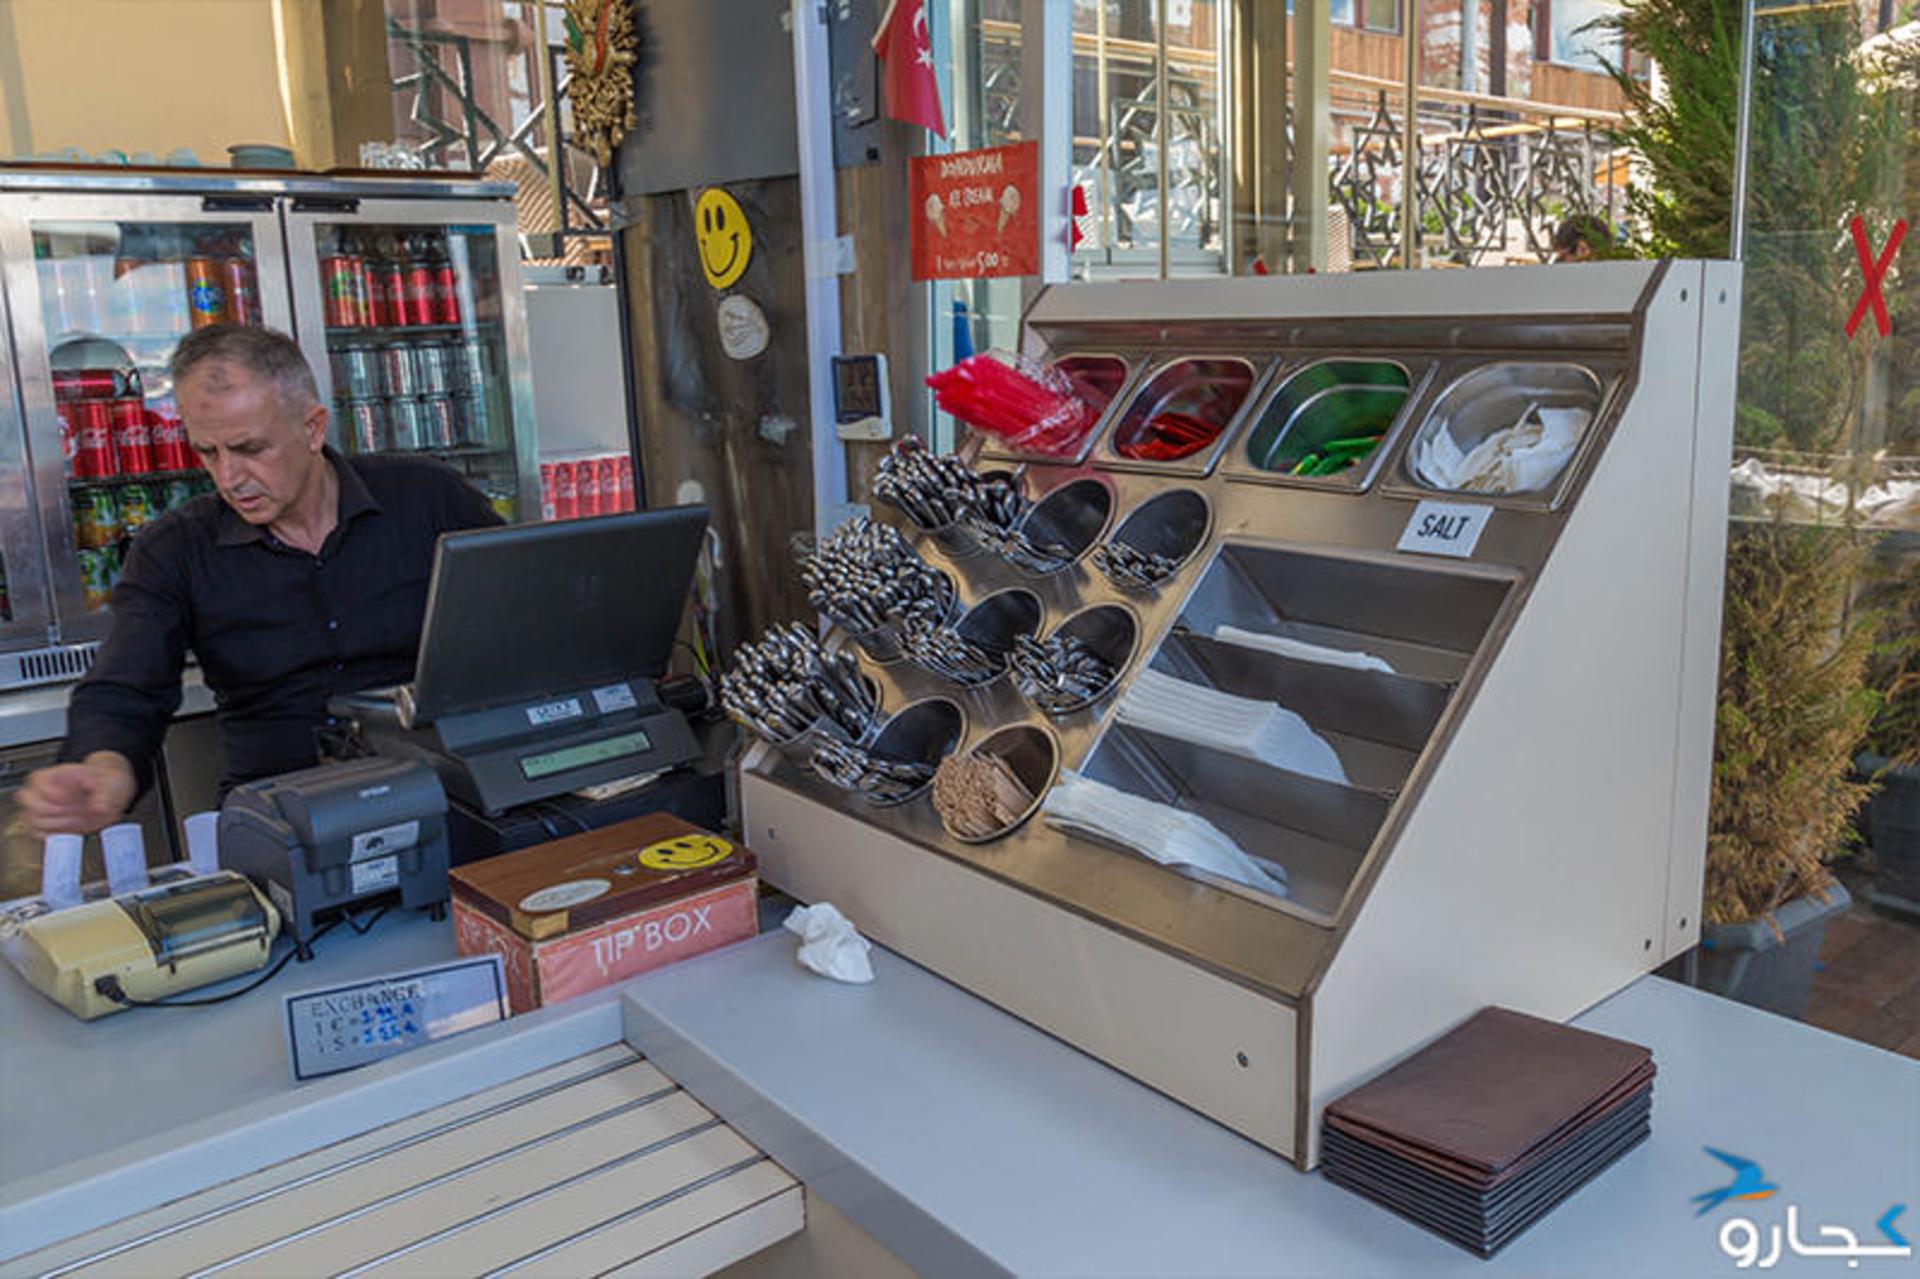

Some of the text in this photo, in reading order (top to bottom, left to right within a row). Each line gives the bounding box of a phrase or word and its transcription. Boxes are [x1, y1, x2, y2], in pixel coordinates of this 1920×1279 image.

[1417, 513, 1471, 540] SALT
[590, 904, 712, 973] TIP BOX
[311, 983, 422, 1018] EXCHANGE
